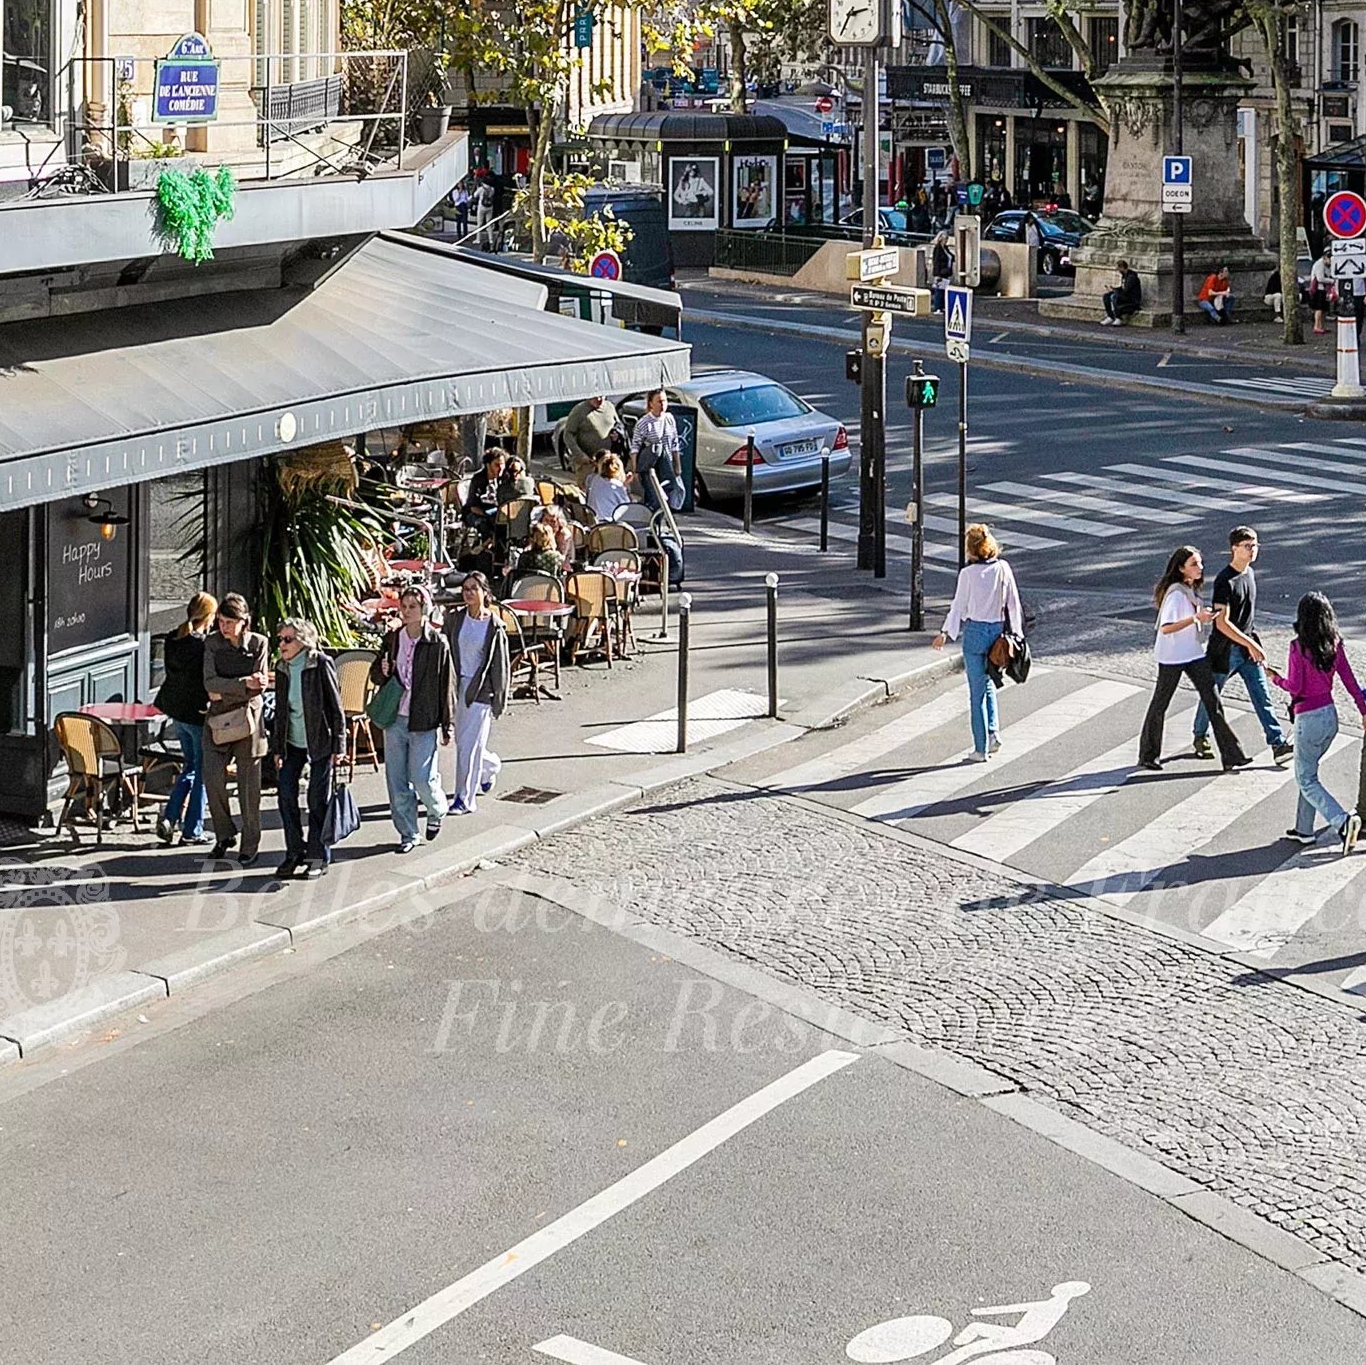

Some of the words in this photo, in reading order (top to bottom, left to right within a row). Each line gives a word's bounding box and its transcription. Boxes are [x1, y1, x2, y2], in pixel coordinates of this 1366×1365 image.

[180, 71, 199, 83] RUE
[159, 85, 171, 97] DE
[171, 84, 216, 97] L'ANCIENNE
[168, 96, 205, 111] COMÉDIE
[1170, 162, 1184, 180] P
[62, 542, 101, 565] Happy
[78, 561, 113, 585] Hours
